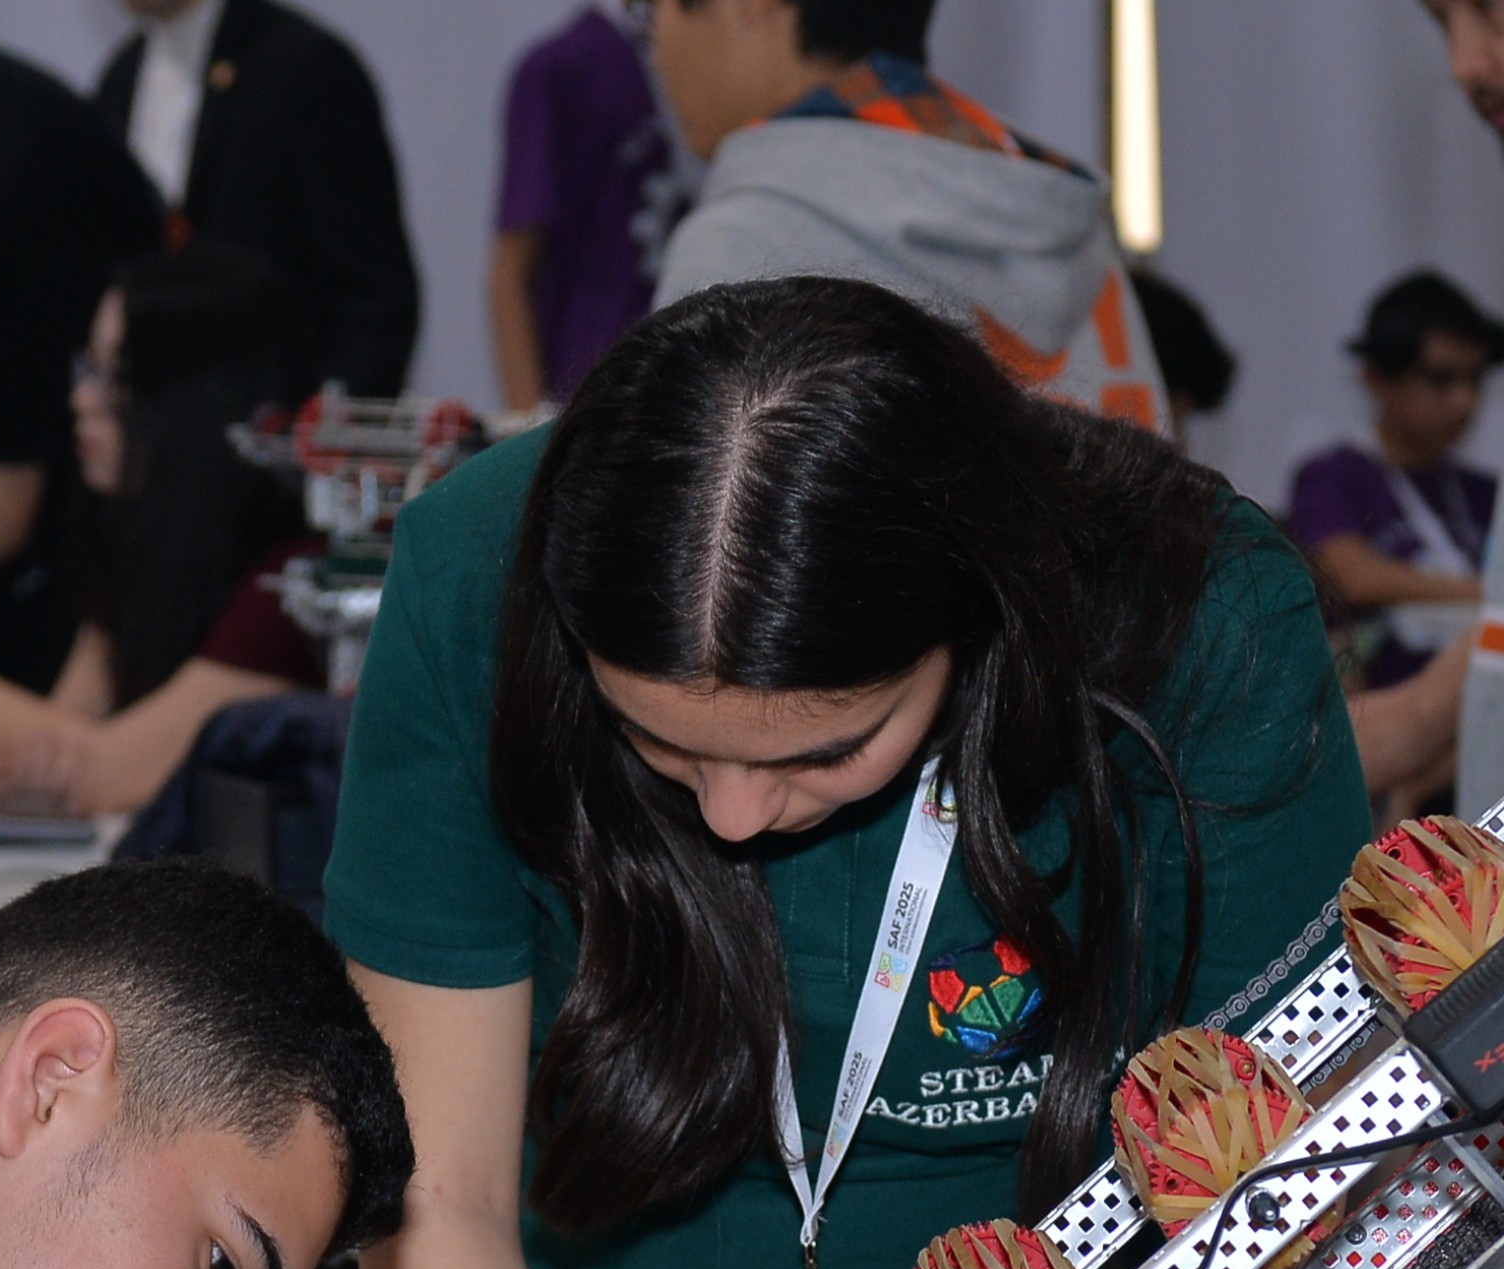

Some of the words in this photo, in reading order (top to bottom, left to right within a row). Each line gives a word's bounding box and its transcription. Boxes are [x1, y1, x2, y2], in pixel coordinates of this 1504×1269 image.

[887, 918, 902, 949] SAF
[895, 881, 914, 918] 2025
[899, 885, 923, 953] INTERNATIONAL
[846, 1050, 863, 1086] 2025
[865, 1091, 1039, 1128] AZERBA
